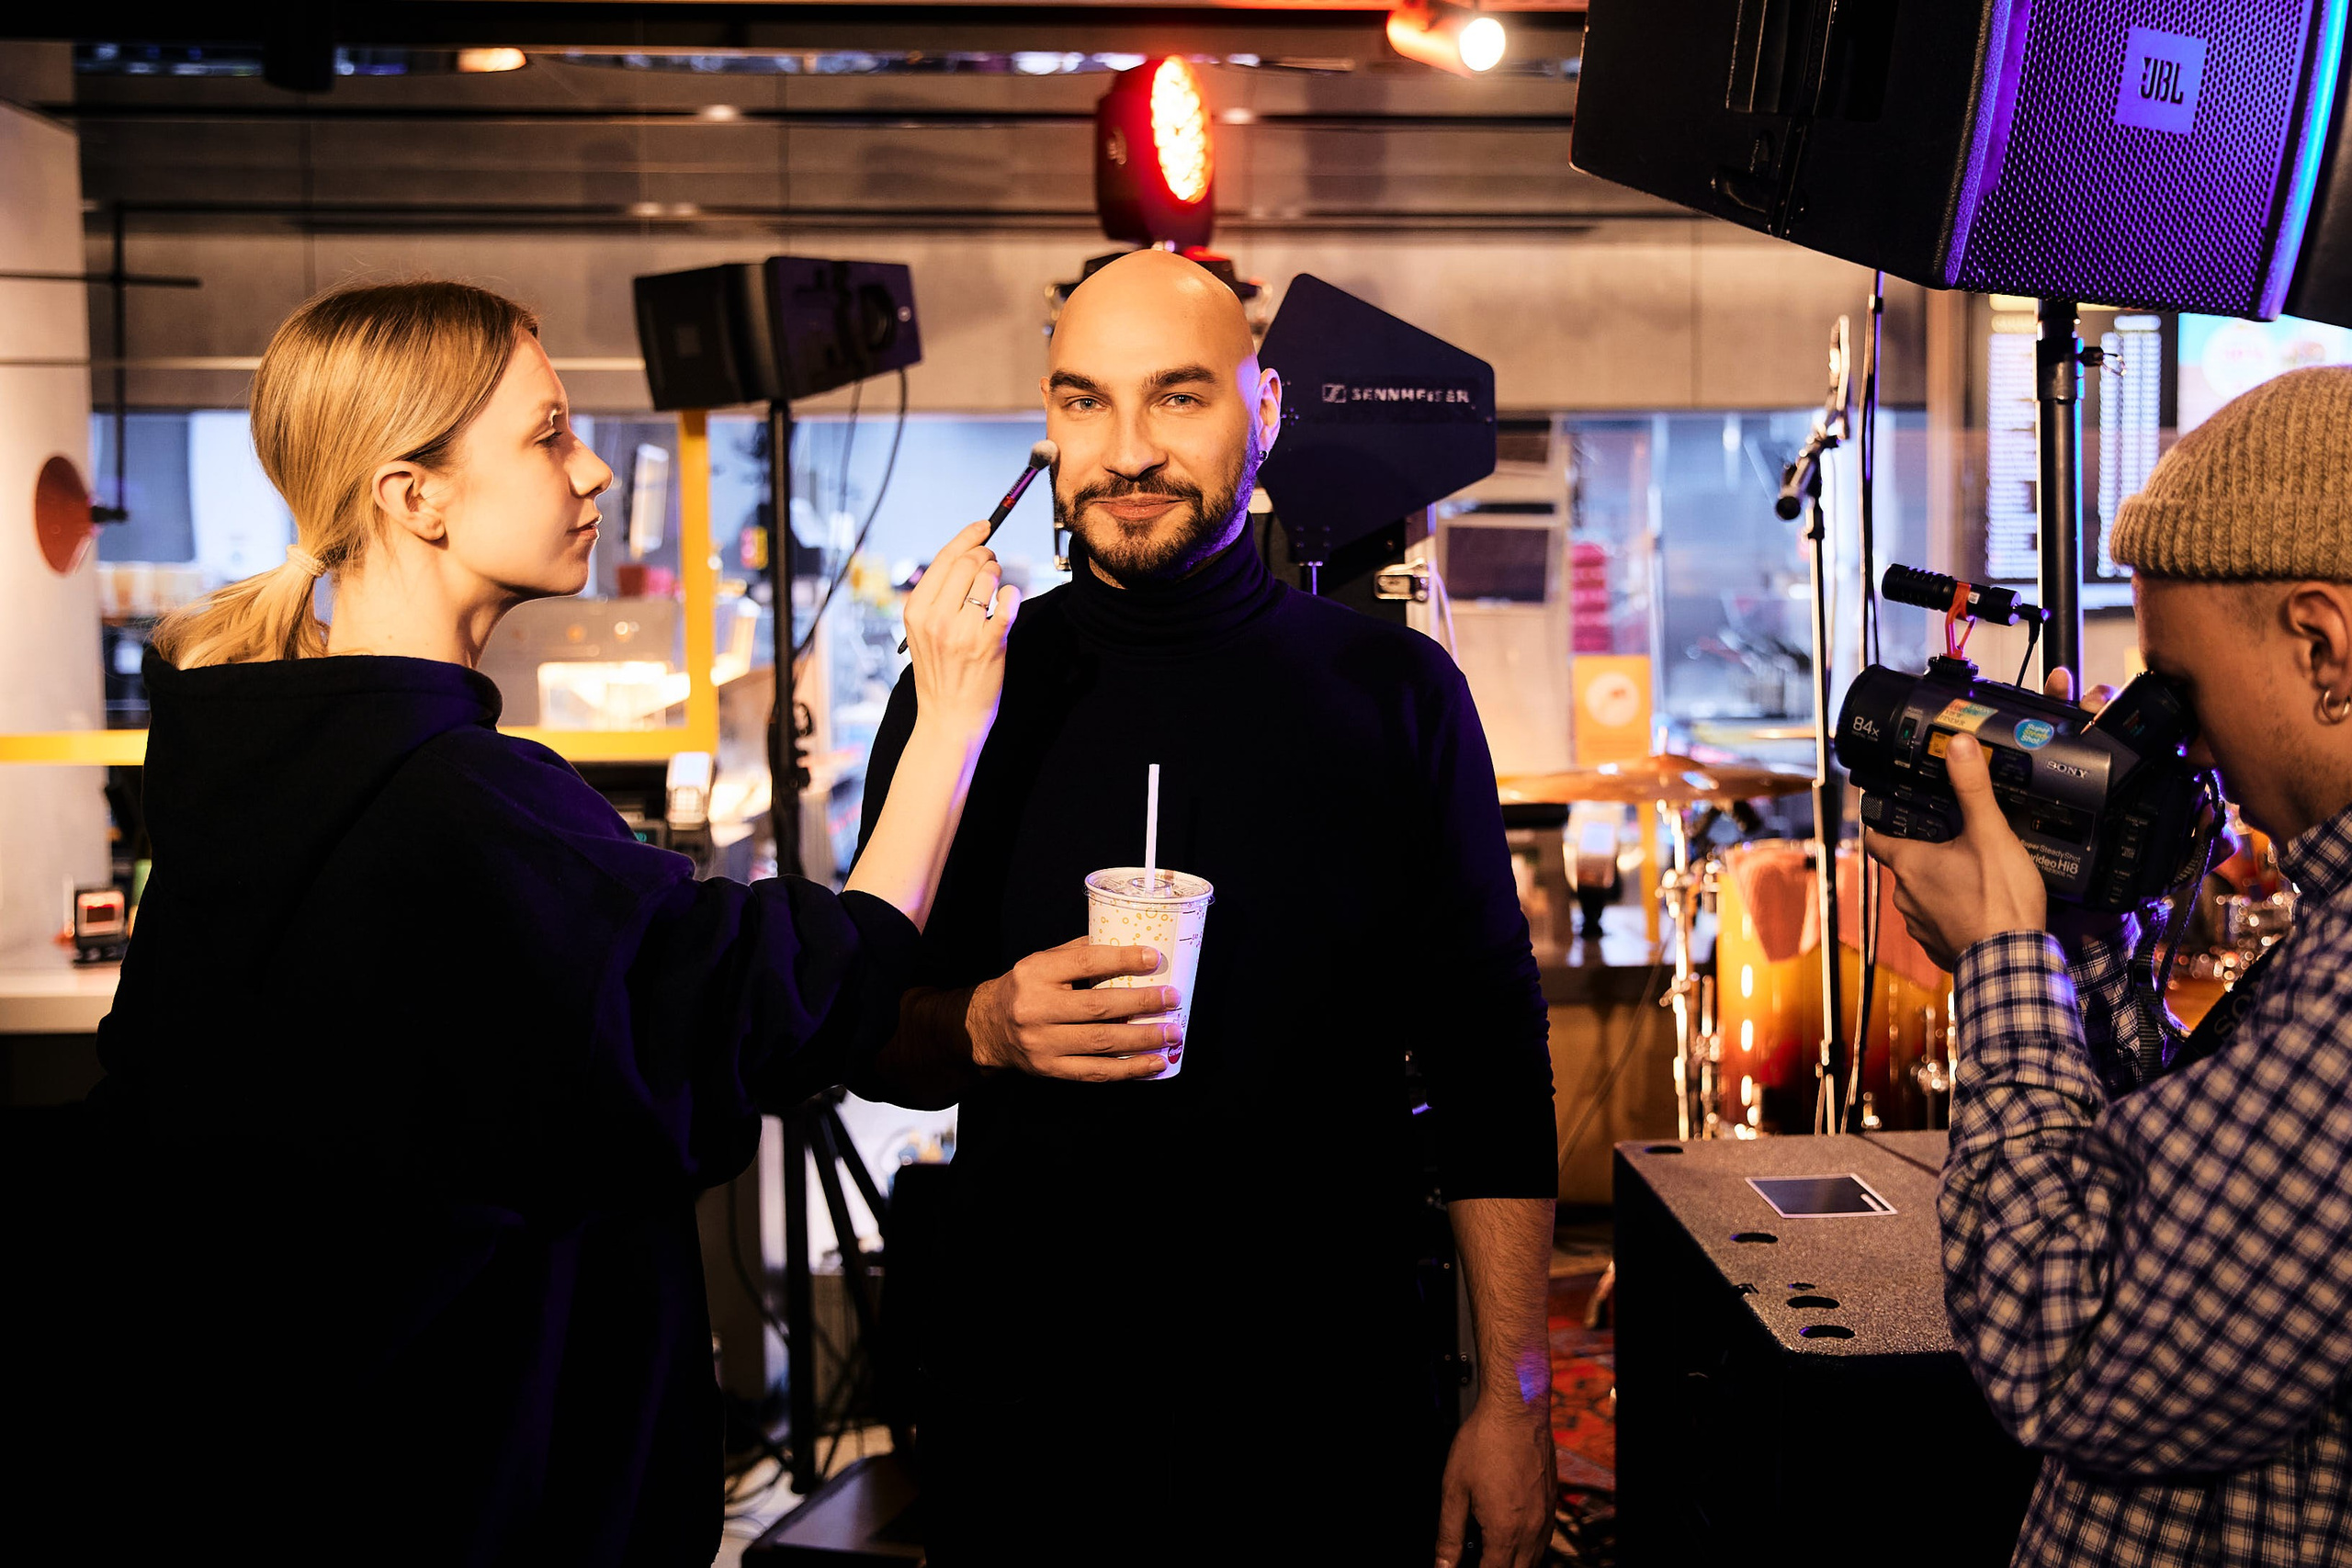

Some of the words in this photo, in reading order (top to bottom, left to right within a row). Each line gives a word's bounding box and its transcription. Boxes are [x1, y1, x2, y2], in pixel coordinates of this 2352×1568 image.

[2140, 57, 2184, 105] JBL
[1351, 387, 1470, 403] SENNHEISER
[2046, 761, 2088, 779] SONY
[2058, 858, 2079, 874] Hi8
